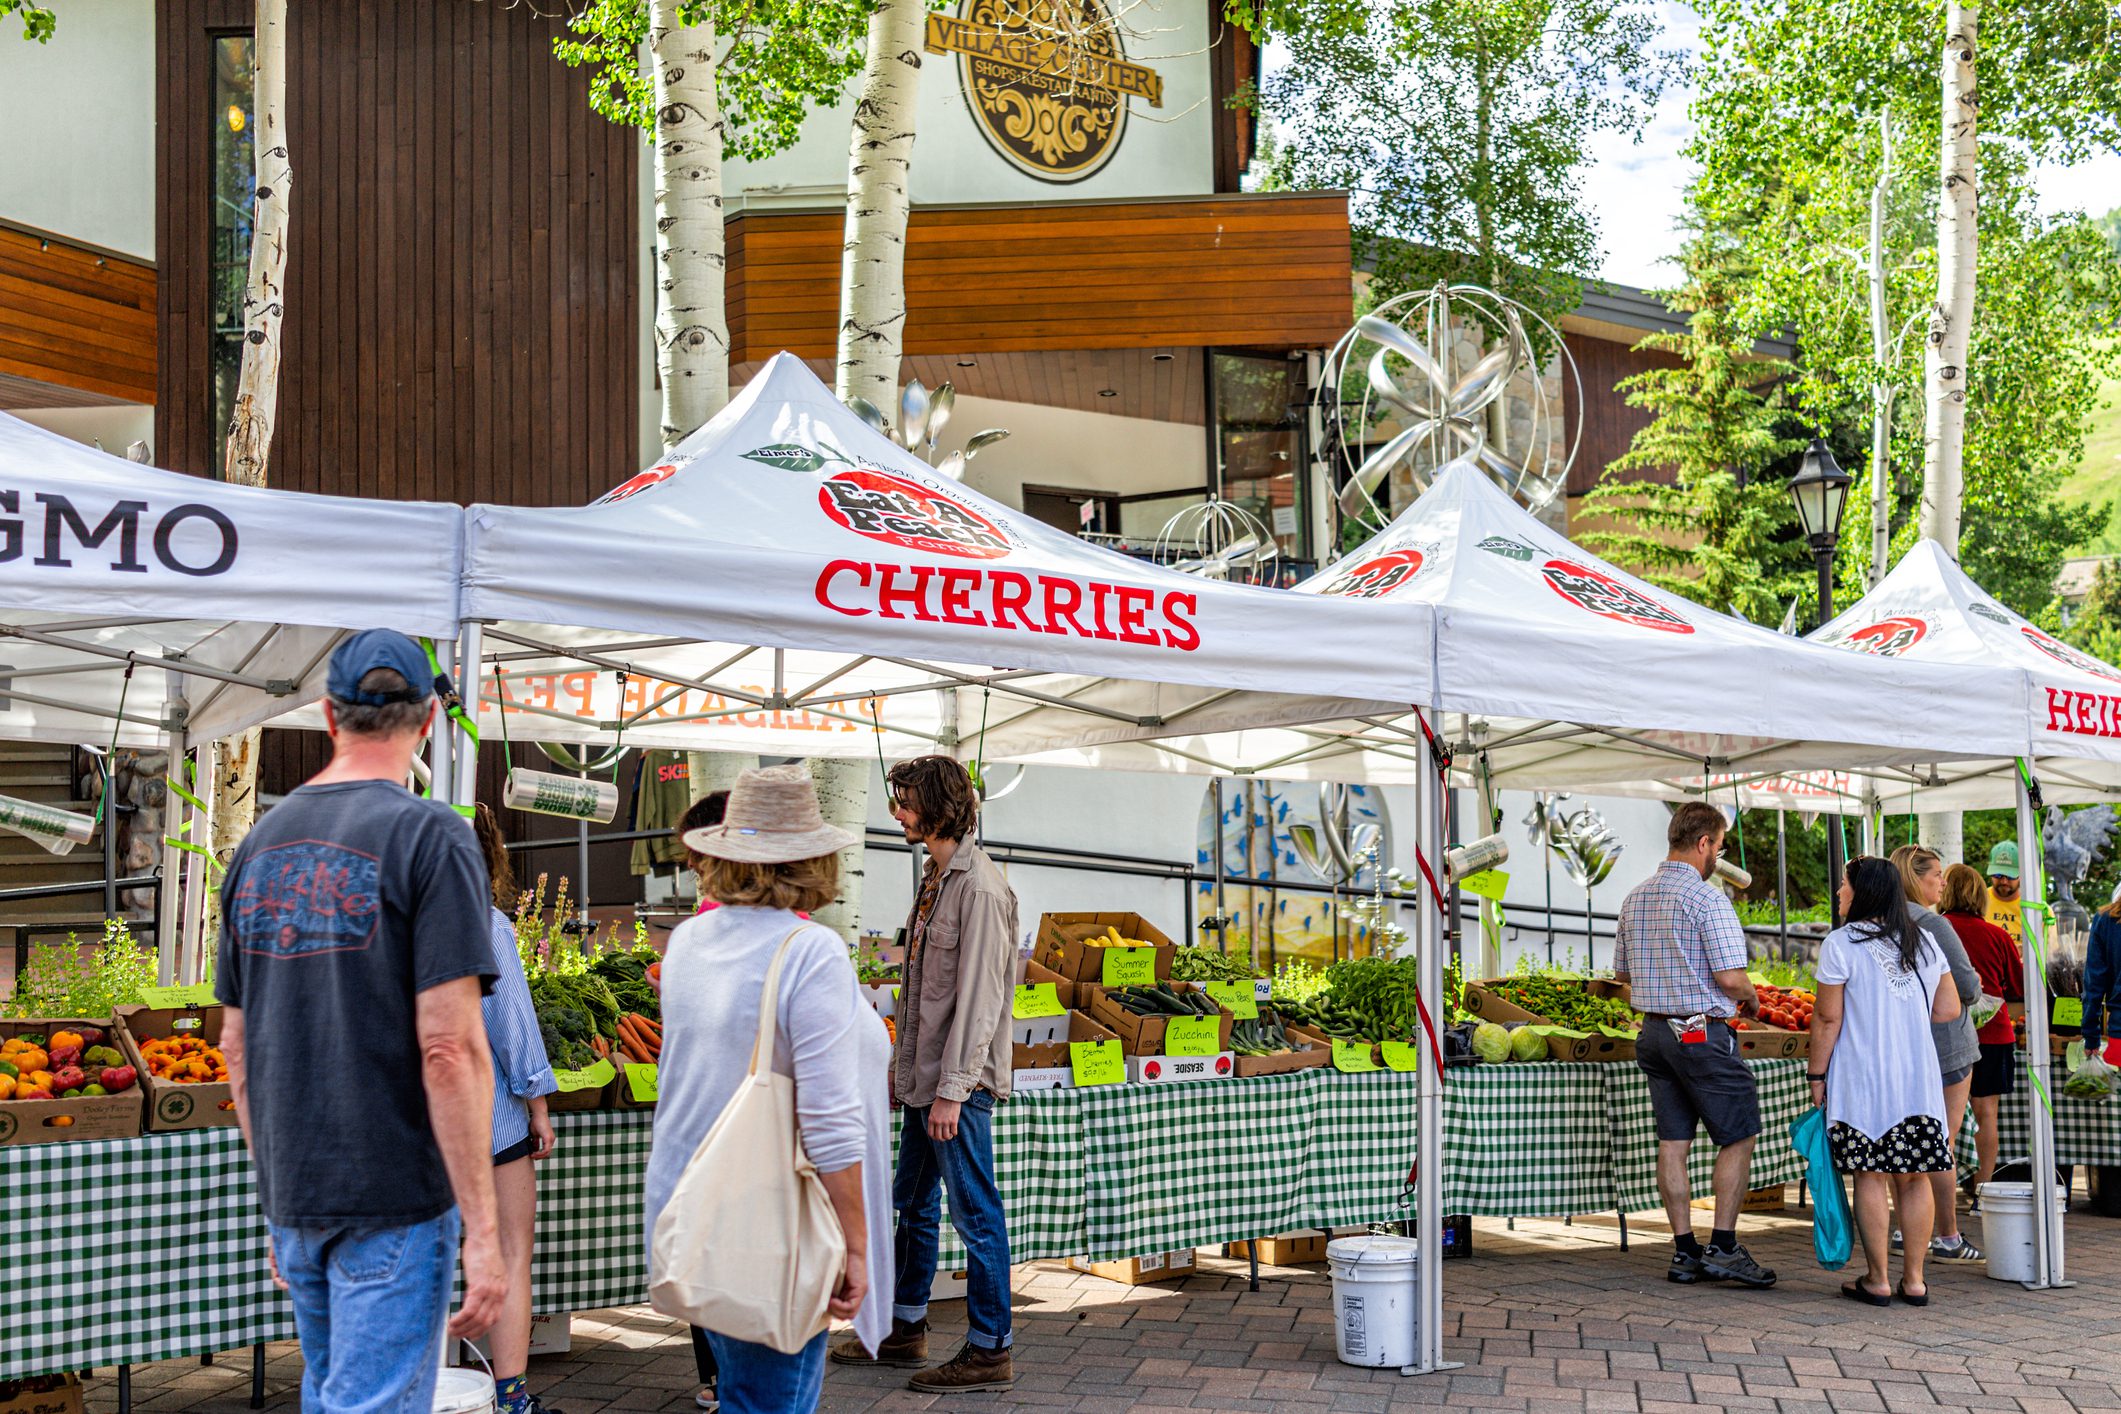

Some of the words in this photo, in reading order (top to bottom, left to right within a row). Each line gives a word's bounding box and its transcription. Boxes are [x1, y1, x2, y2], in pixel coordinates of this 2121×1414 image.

[934, 17, 1043, 67] VILLAGE
[974, 59, 1018, 81] SHOPS
[758, 448, 812, 458] Elmer's
[856, 455, 915, 480] Artisan
[923, 477, 991, 516] Organic
[822, 480, 927, 518] Eat
[931, 500, 986, 529] A
[841, 507, 1013, 551] Peach
[895, 535, 987, 556] Farms
[1542, 568, 1619, 599] Eat
[1612, 583, 1657, 607] A
[815, 560, 1201, 652] CHERRIES
[1567, 591, 1690, 625] Peach
[1993, 912, 2017, 922] EAT
[1112, 956, 1150, 969] Summer
[1116, 969, 1147, 981] Squash
[1213, 991, 1235, 1003] Snow
[1235, 990, 1251, 1003] Peas
[1172, 1026, 1217, 1040] Zucchini
[1174, 1062, 1205, 1074] SEASIDE
